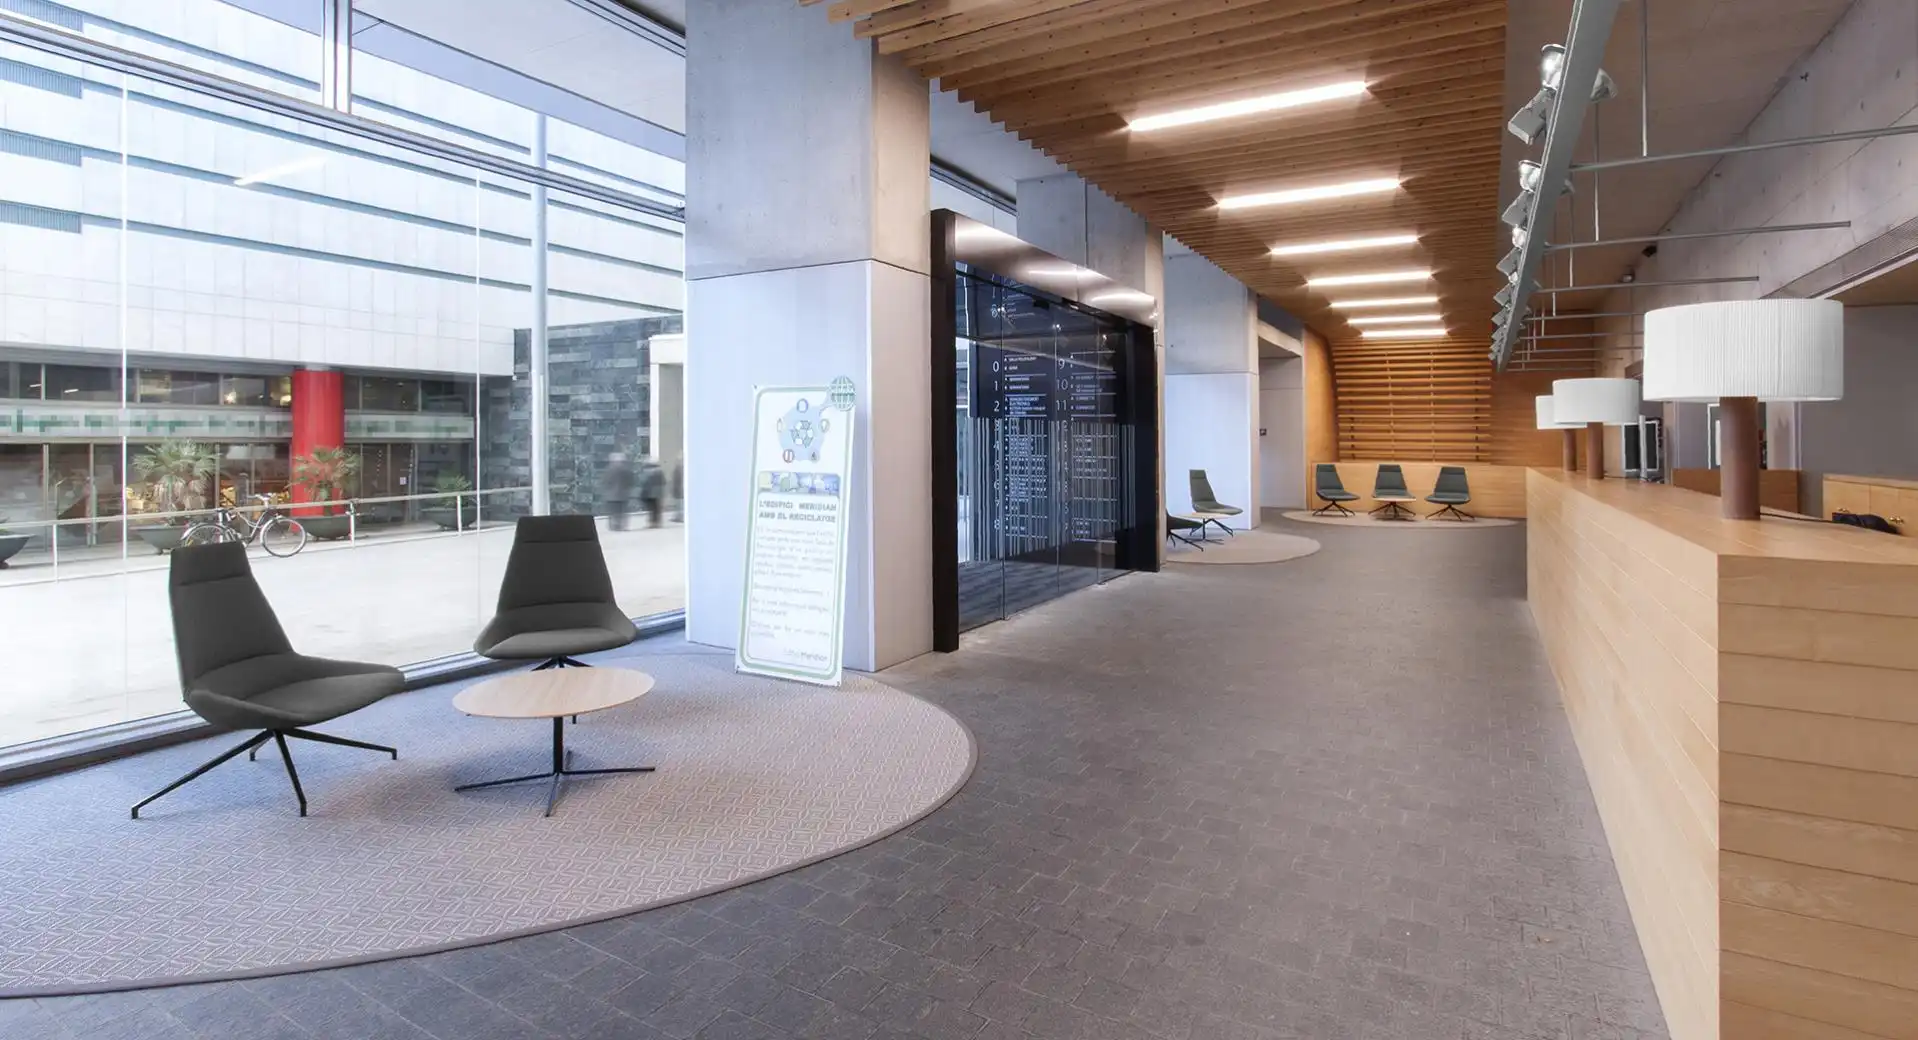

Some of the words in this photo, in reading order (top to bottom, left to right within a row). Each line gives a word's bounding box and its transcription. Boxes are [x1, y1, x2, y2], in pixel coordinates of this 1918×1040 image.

[992, 361, 1000, 373] 0
[1058, 358, 1065, 370] 9
[994, 380, 999, 391] 1
[1056, 379, 1068, 390] 10
[993, 400, 1000, 412] 2
[1056, 399, 1067, 411] 11
